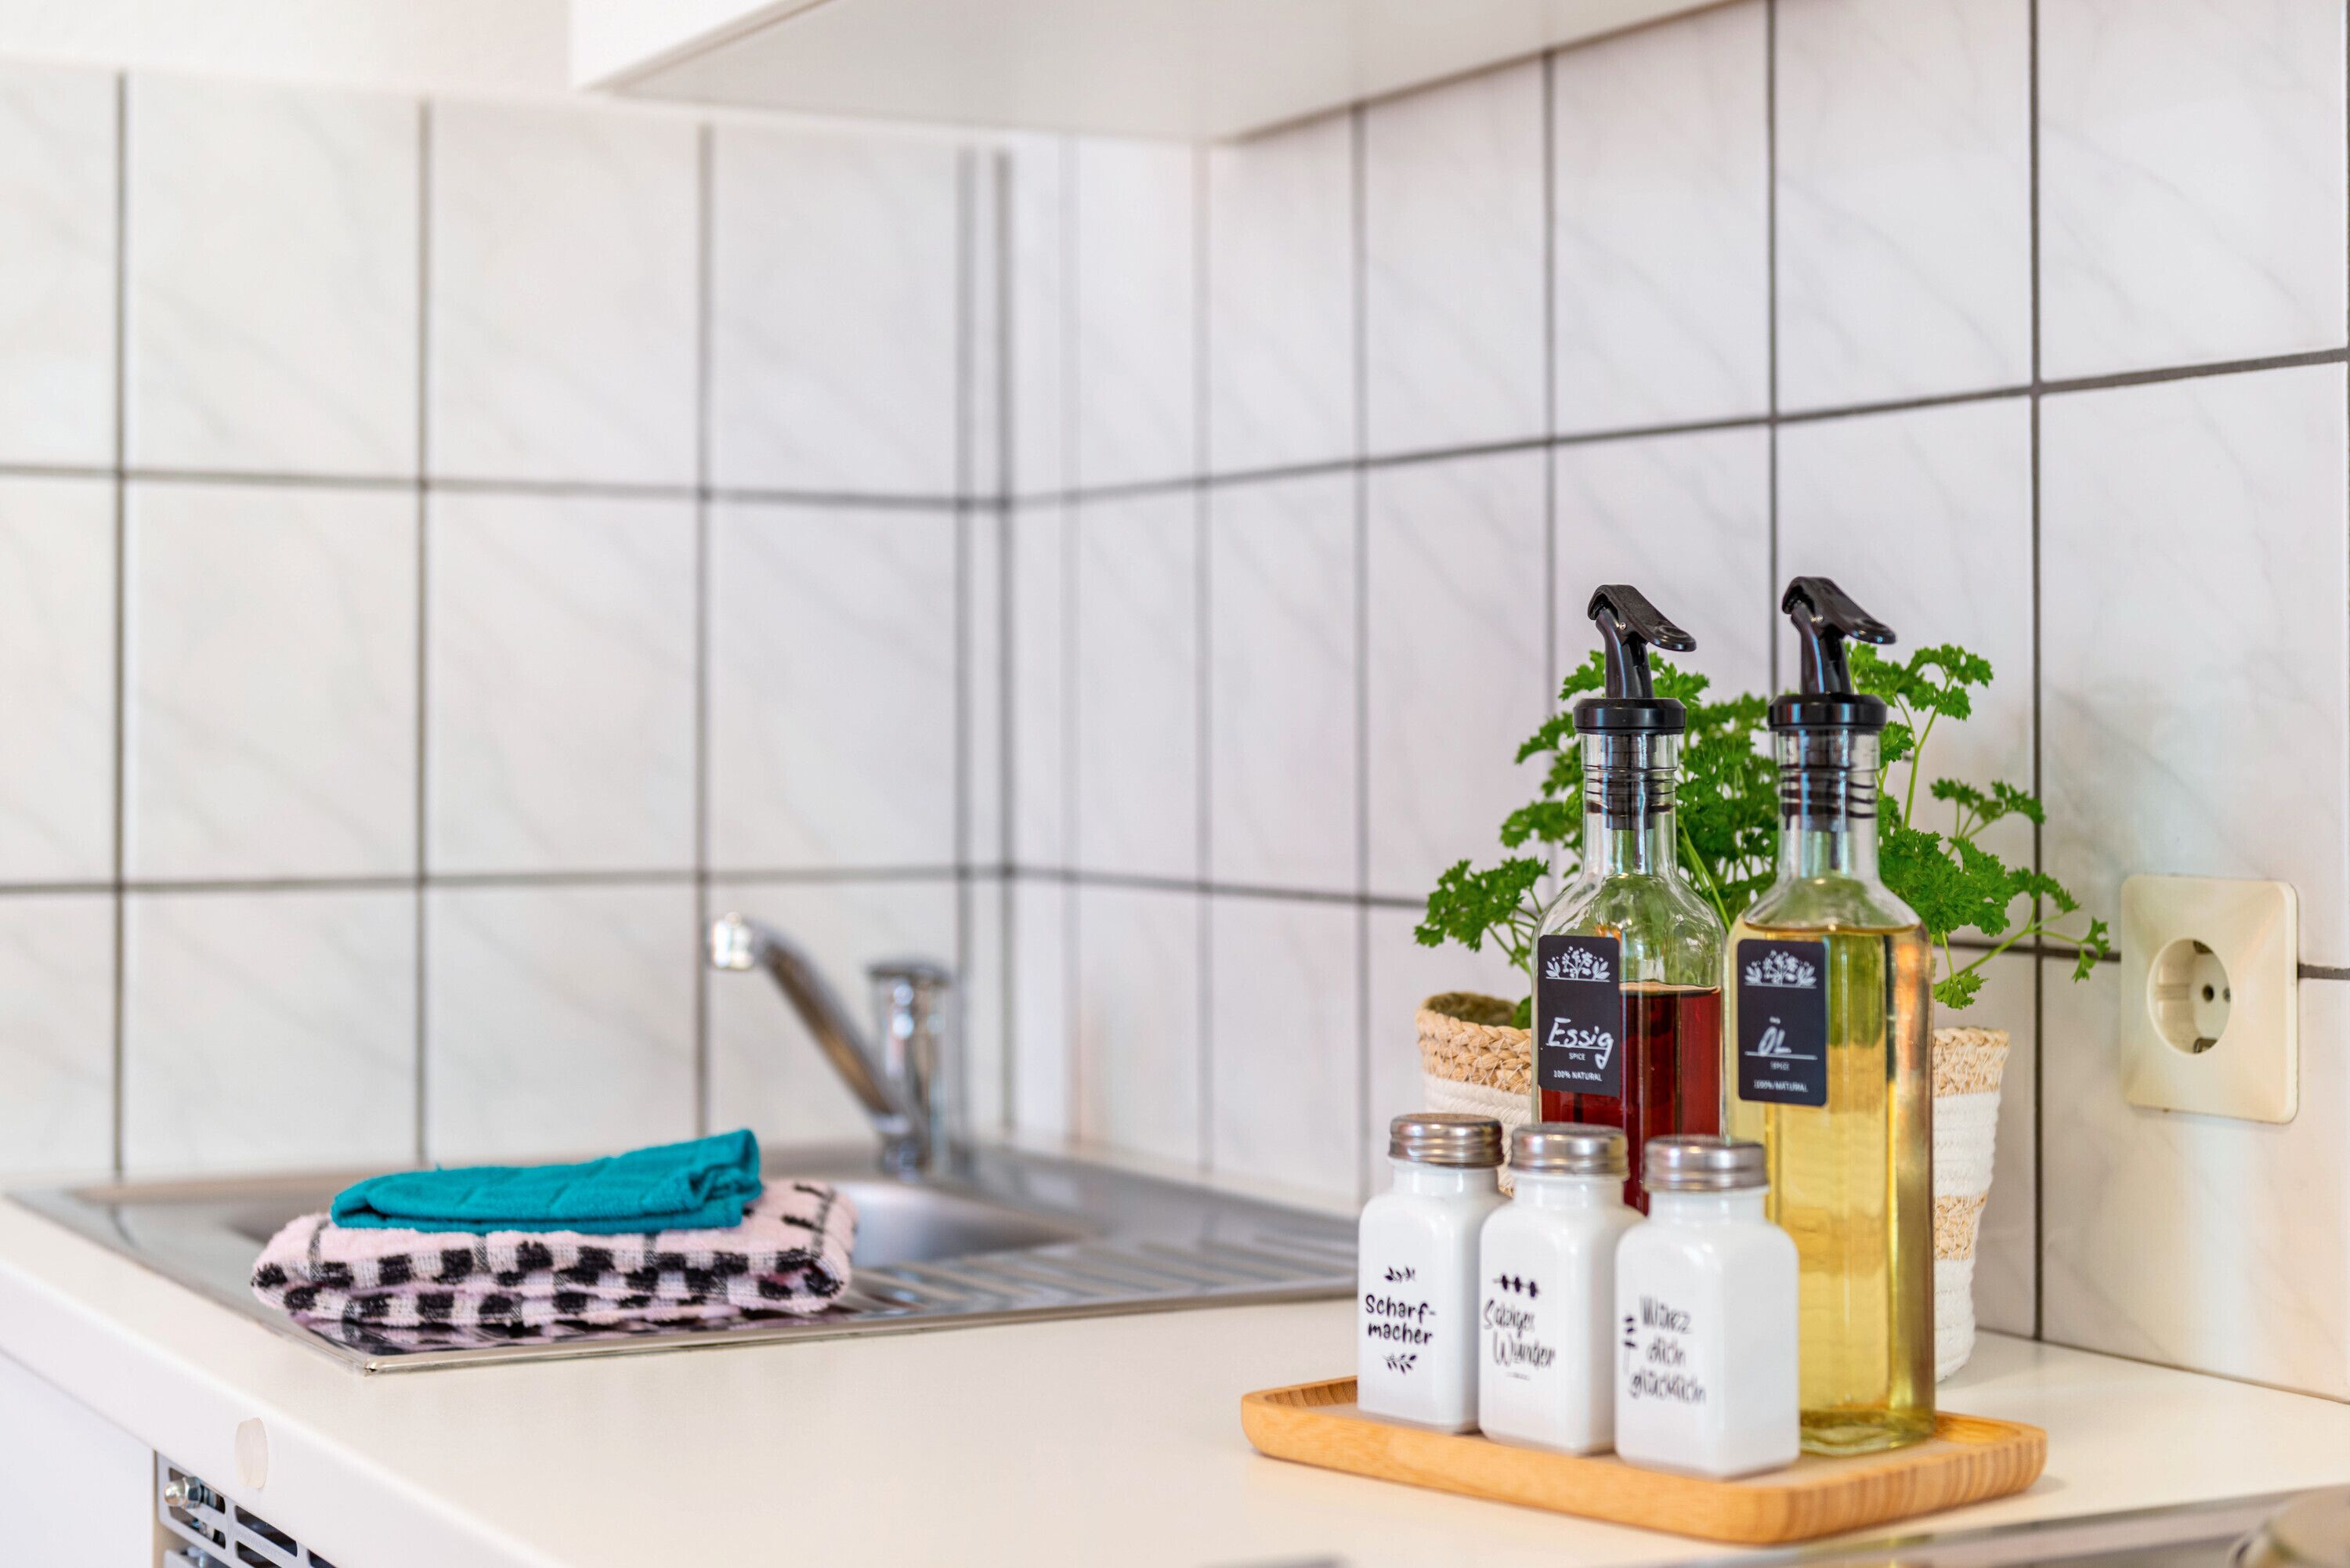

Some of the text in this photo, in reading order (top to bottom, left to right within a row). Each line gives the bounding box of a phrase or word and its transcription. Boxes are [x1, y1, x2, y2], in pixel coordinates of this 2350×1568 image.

[1548, 1017, 1614, 1070] Essig
[1568, 1052, 1586, 1061] SPICE
[1553, 1070, 1603, 1082] 100% NATURAL
[1770, 1061, 1790, 1071] SPICE
[1754, 1079, 1809, 1093] 100% NATURAL
[1365, 1294, 1435, 1324] Scharf-
[1368, 1322, 1433, 1345] macher
[1492, 1331, 1556, 1369] Wunder
[1646, 1334, 1686, 1367] dich
[1629, 1367, 1706, 1404] glücklich
